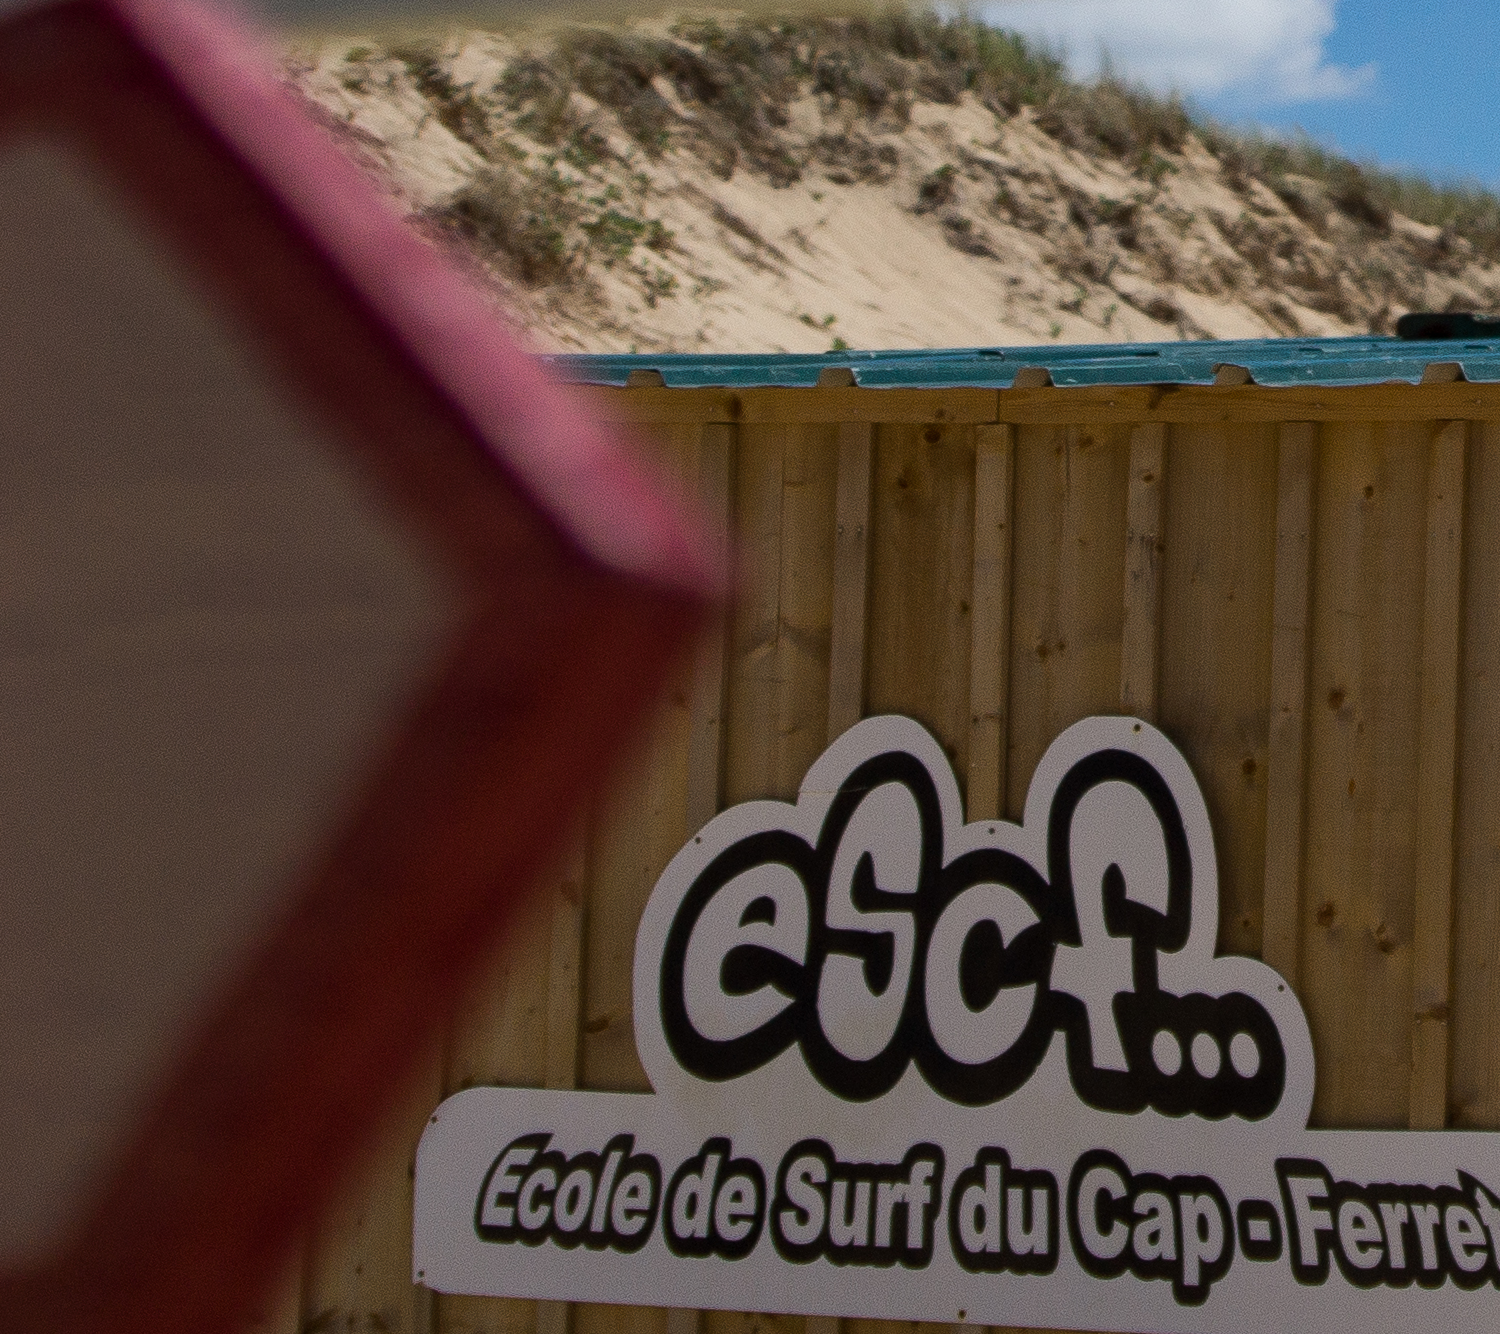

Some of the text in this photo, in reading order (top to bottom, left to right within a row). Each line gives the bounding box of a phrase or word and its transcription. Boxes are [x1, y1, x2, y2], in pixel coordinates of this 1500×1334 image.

[475, 1131, 664, 1256] Ecole
[664, 1136, 768, 1260] de
[770, 1138, 945, 1268] Surf
[949, 1146, 1060, 1276] du
